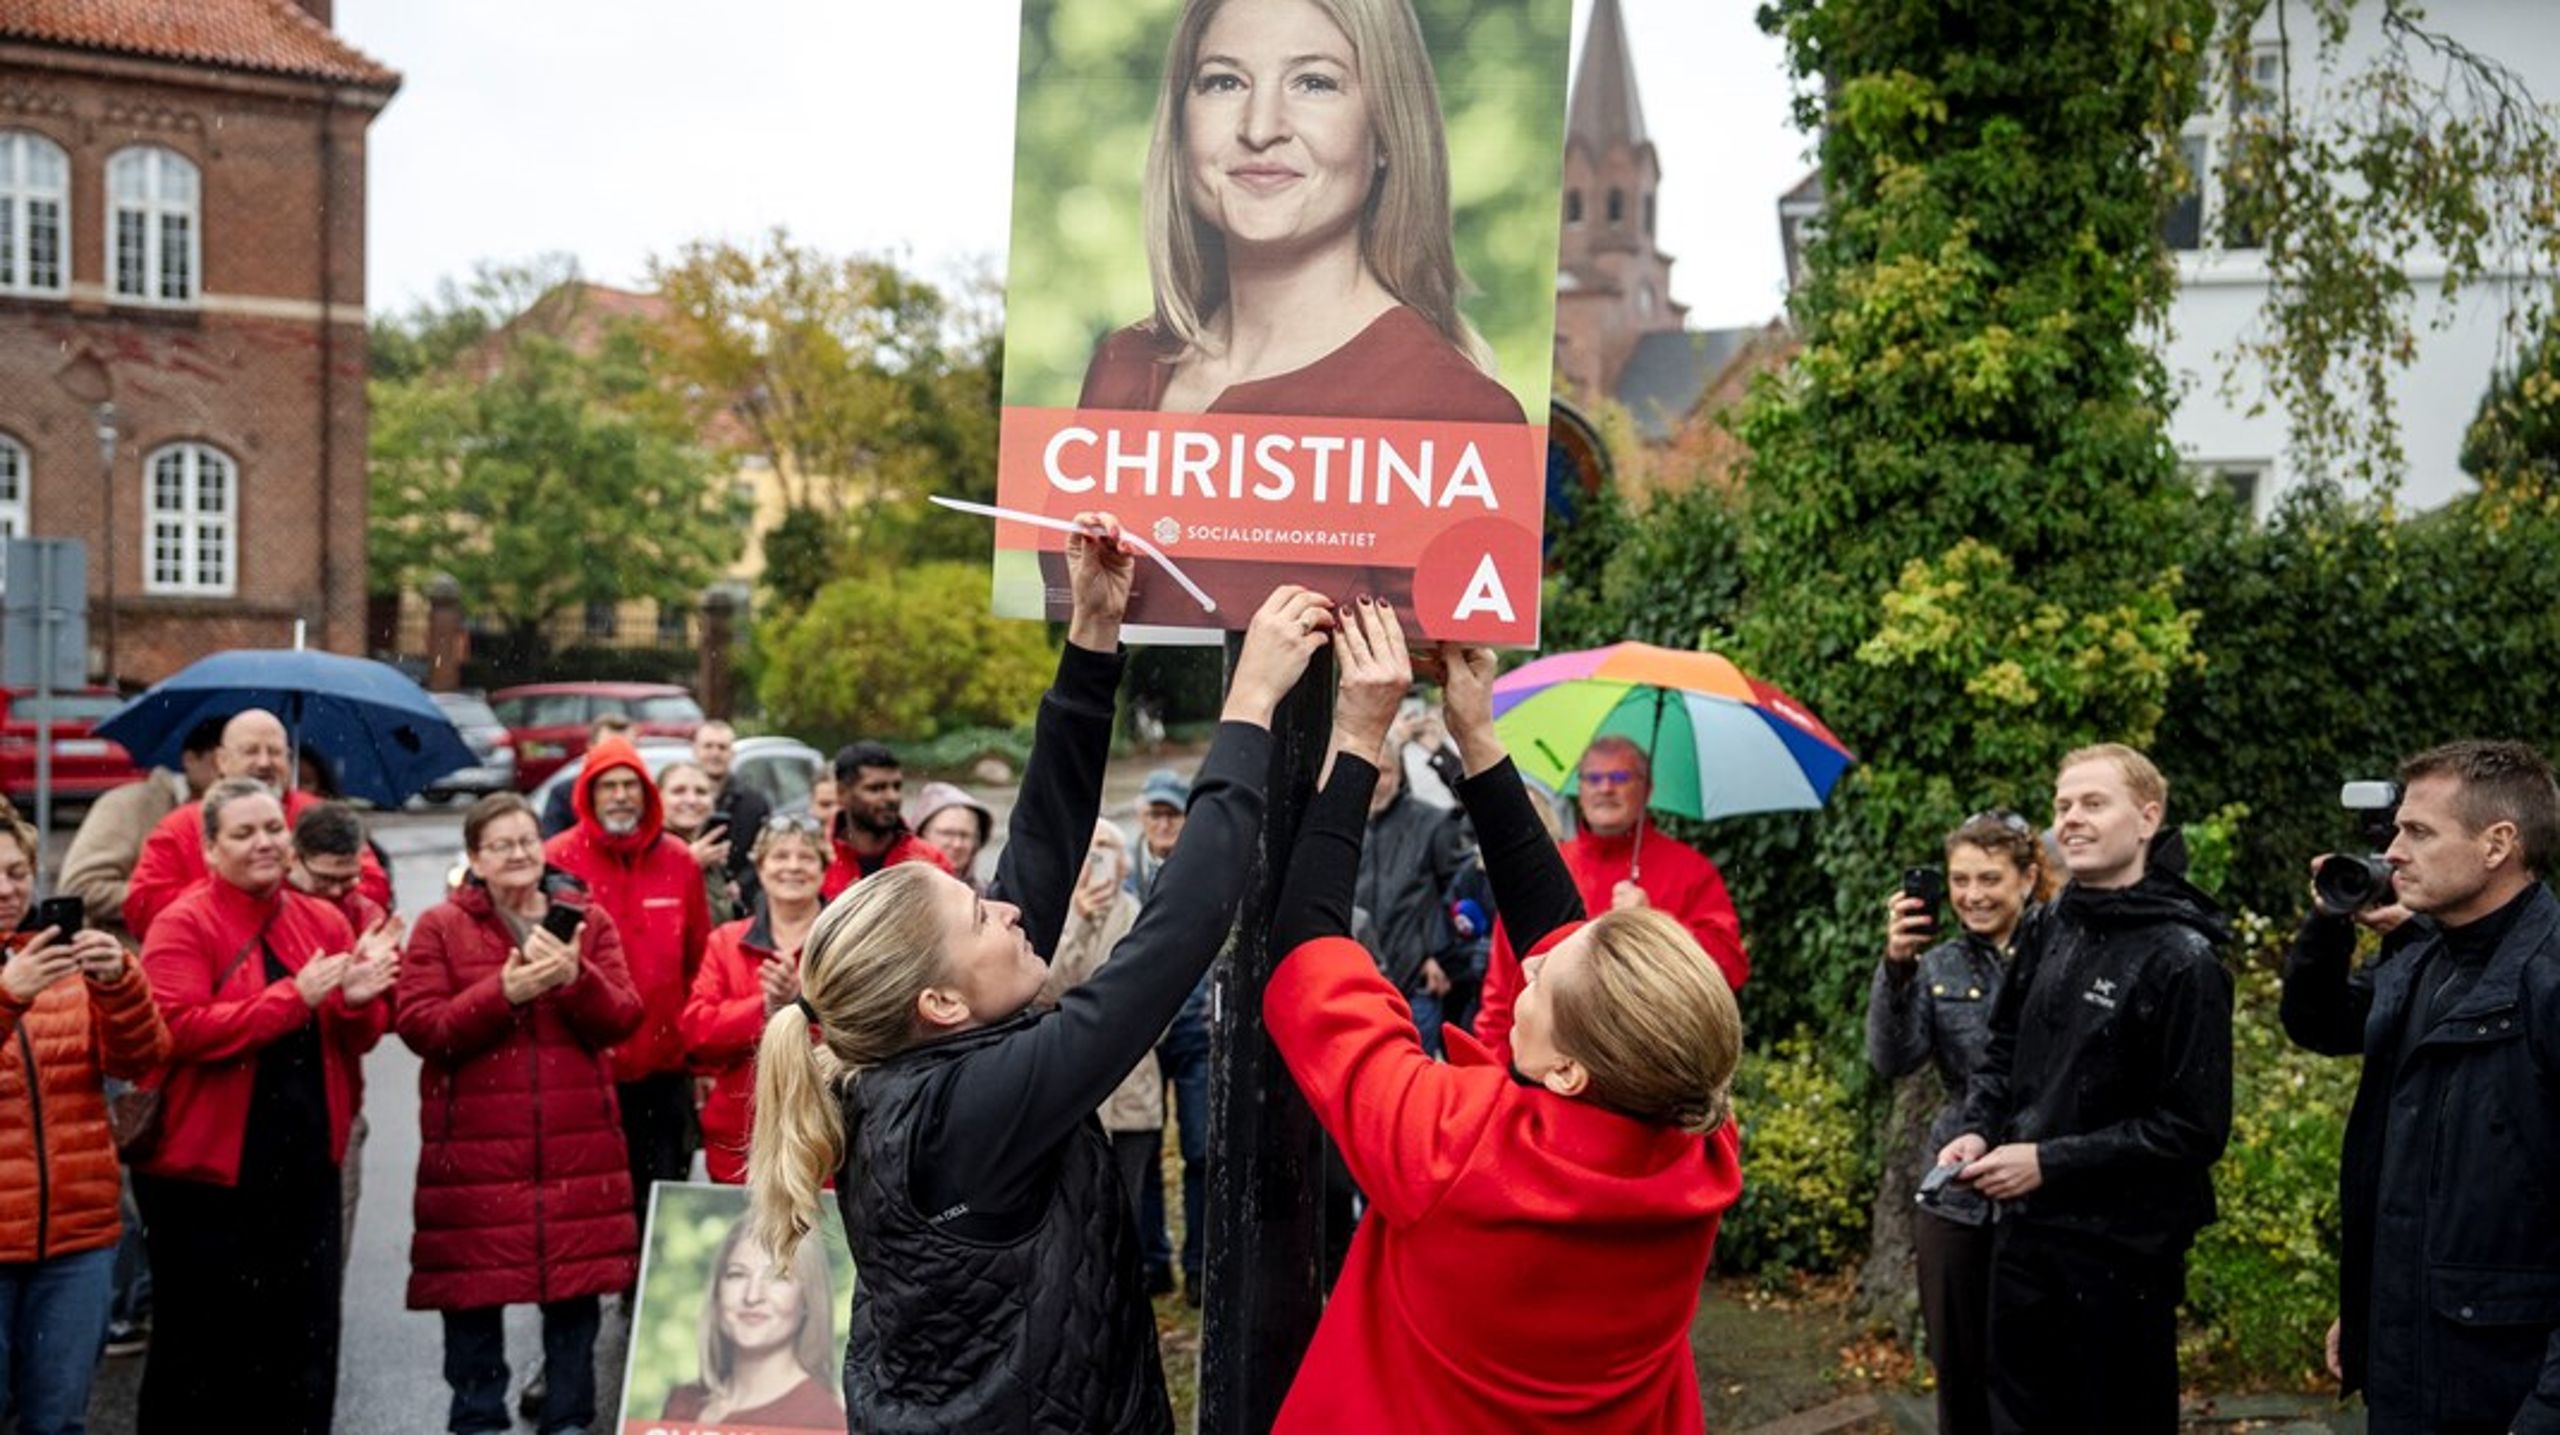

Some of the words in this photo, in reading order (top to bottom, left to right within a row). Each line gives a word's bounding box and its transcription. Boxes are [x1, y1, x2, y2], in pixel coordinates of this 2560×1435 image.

[1043, 427, 1499, 510] CHRISTINA
[1187, 525, 1376, 547] SOCIALDEMOKRATIET
[1452, 553, 1516, 623] A
